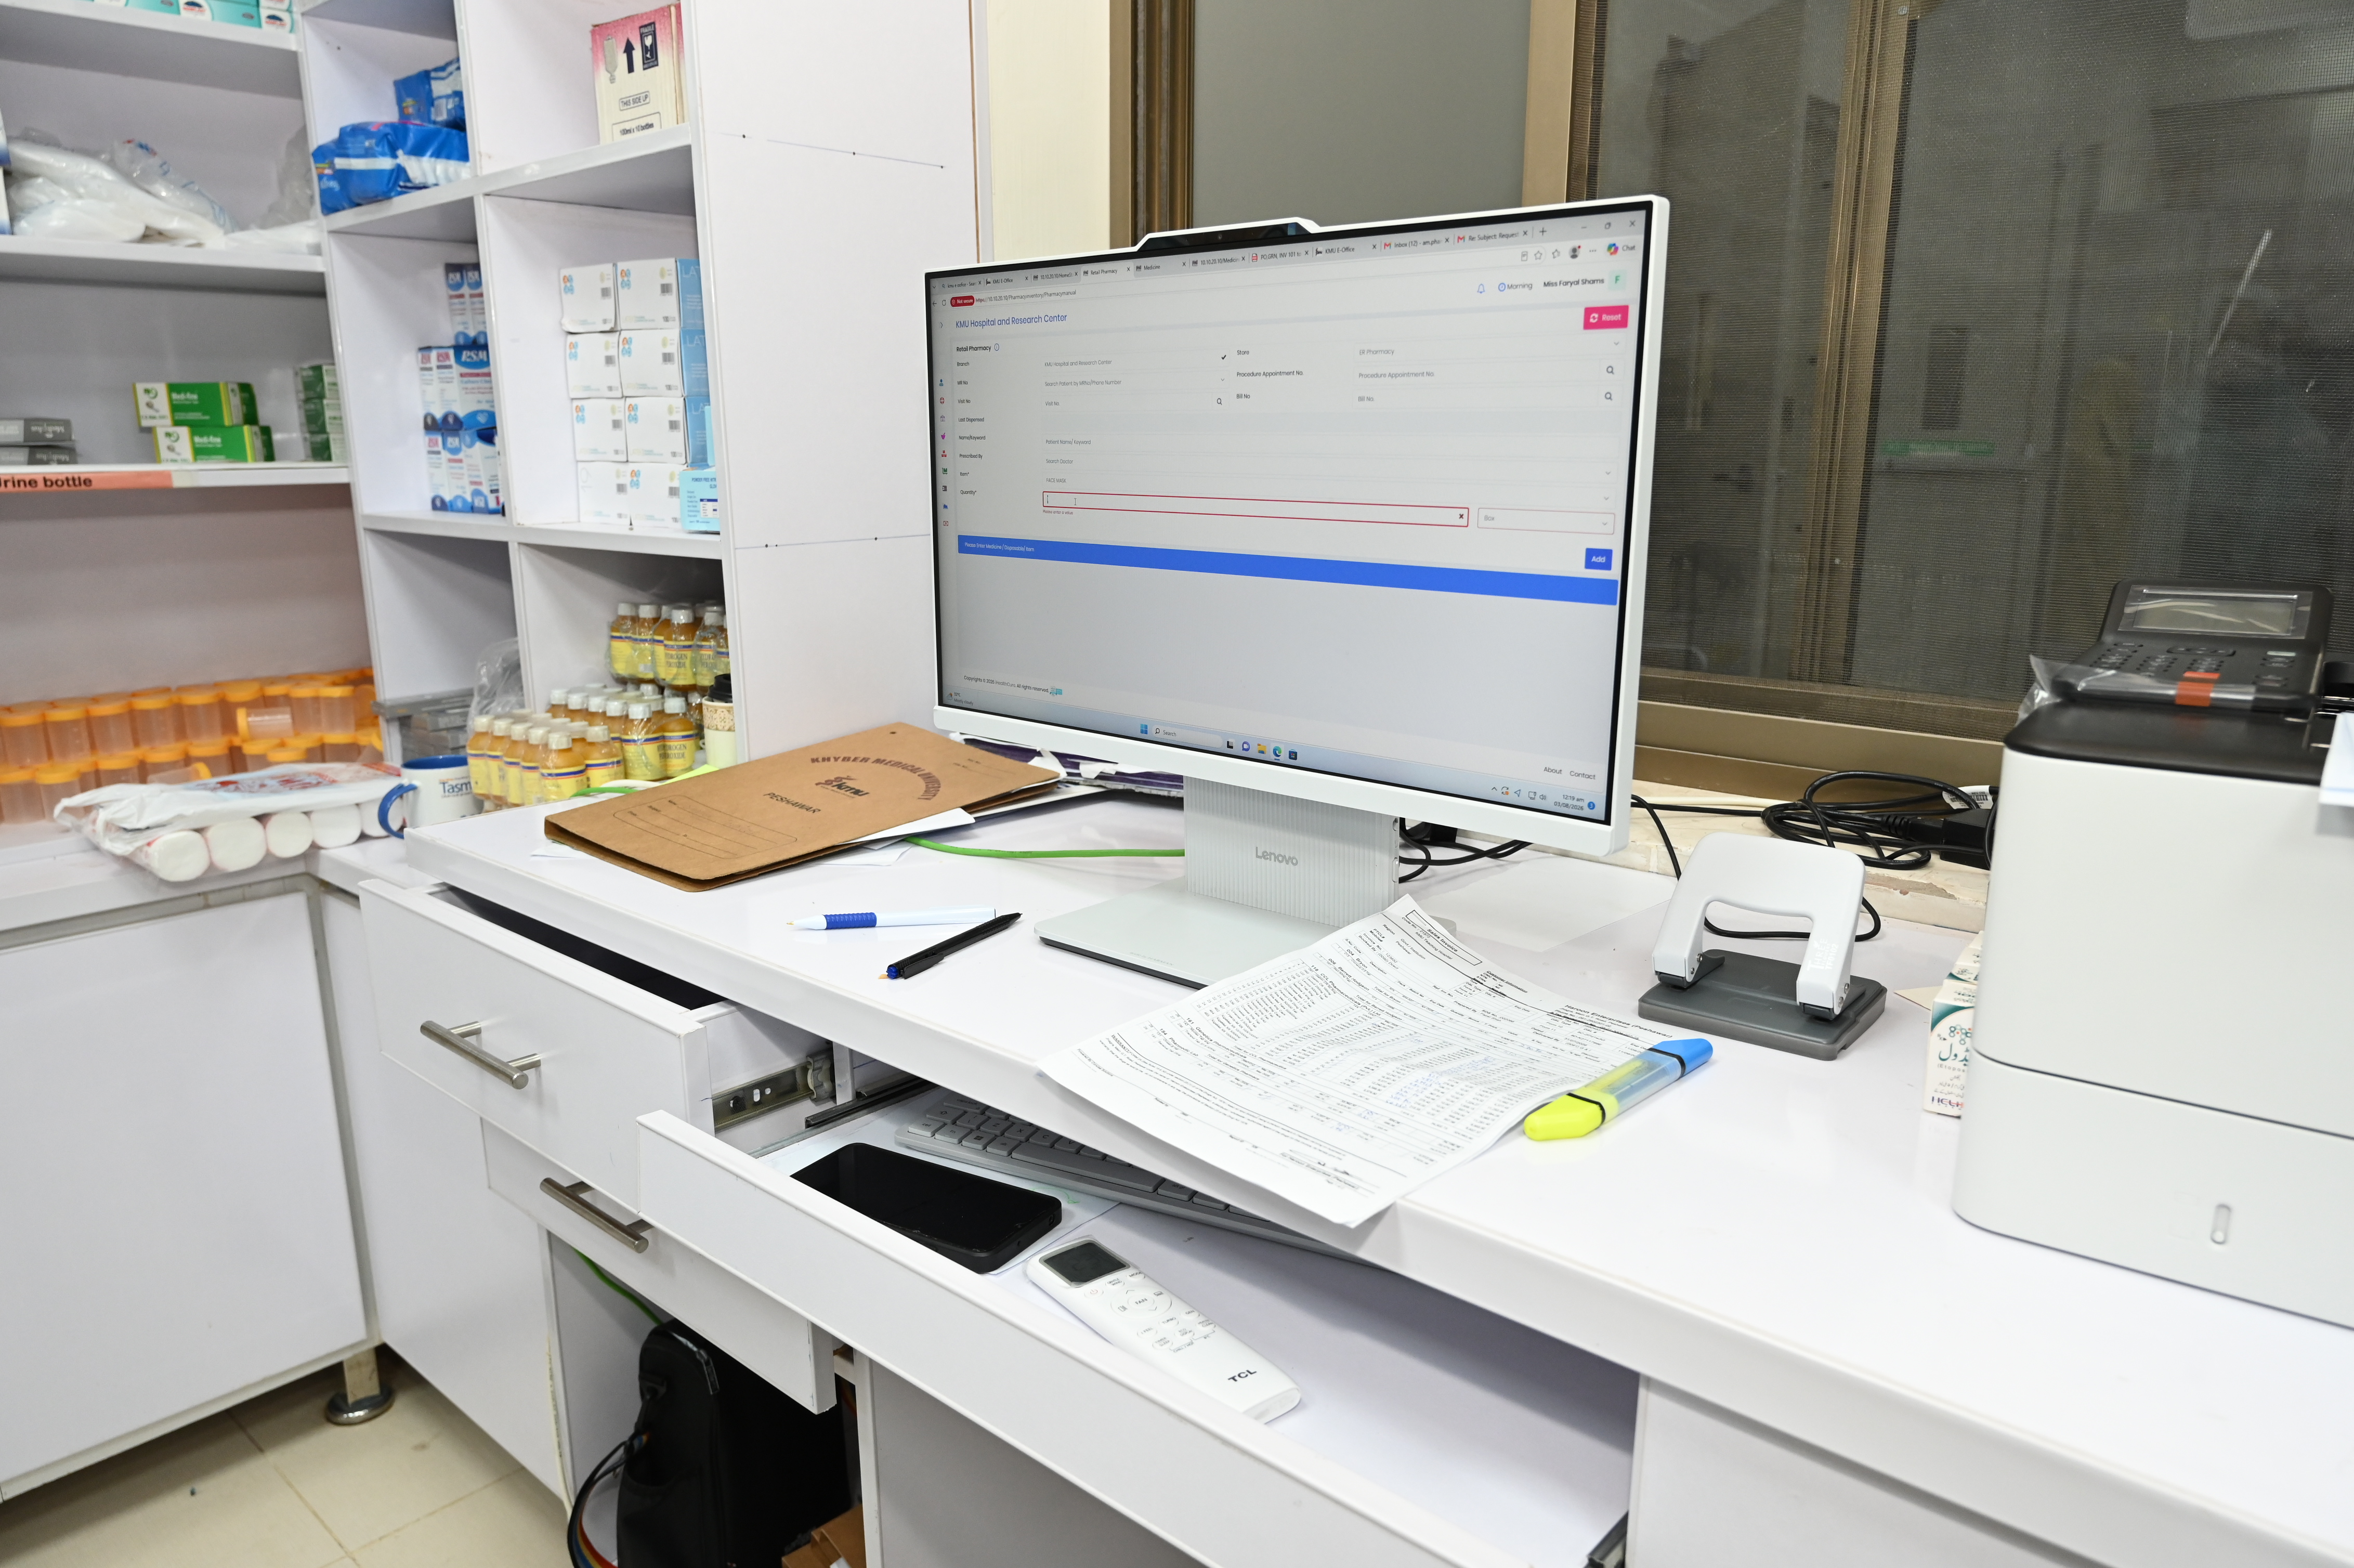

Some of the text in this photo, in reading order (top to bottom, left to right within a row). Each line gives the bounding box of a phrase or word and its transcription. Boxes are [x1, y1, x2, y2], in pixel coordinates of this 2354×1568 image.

[621, 100, 631, 108] THIS
[641, 123, 655, 131] bottles
[1559, 279, 1579, 288] Faryal
[1615, 276, 1620, 284] F
[1508, 282, 1533, 291] Morning
[956, 313, 1067, 329] KMU Hospital and Research Center
[1262, 370, 1294, 378] Appointment
[1388, 371, 1424, 380] Appointment
[0, 476, 93, 488] rine bottle
[1591, 555, 1606, 564] Add
[964, 675, 983, 684] Copyrights
[1162, 729, 1177, 738] Search
[871, 757, 925, 774] MEDICAL
[1544, 766, 1596, 780] About Contact
[831, 781, 870, 796] kmu
[763, 792, 821, 814] PESHAWAR
[1553, 801, 1584, 811] 03/08/2026
[1256, 846, 1298, 866] Lenovo
[1402, 917, 1411, 925] Code
[1382, 924, 1395, 935] Region
[1358, 935, 1372, 947] Booked
[1363, 933, 1376, 945] Invoice
[1427, 928, 1458, 952] Sales Invoice
[1395, 940, 1411, 955] Peshawar
[1410, 947, 1426, 960] Institution
[1424, 937, 1438, 951] Teaching
[1438, 949, 1453, 960] Hospital
[1353, 946, 1387, 975] Code Description
[1825, 943, 1839, 970] TF0102
[1356, 958, 1368, 969] Bryon
[1338, 966, 1352, 978] Barrett
[1351, 977, 1370, 991] Hodgson
[1320, 973, 1329, 982] CCL
[1329, 980, 1362, 1008] Pharmaceuticals
[1564, 1004, 1673, 1038] Haroon Enterprises (Peshawar)
[1195, 1026, 1213, 1042] Genetics
[1161, 1316, 1176, 1325] TURBO
[1227, 1368, 1258, 1383] TCL
